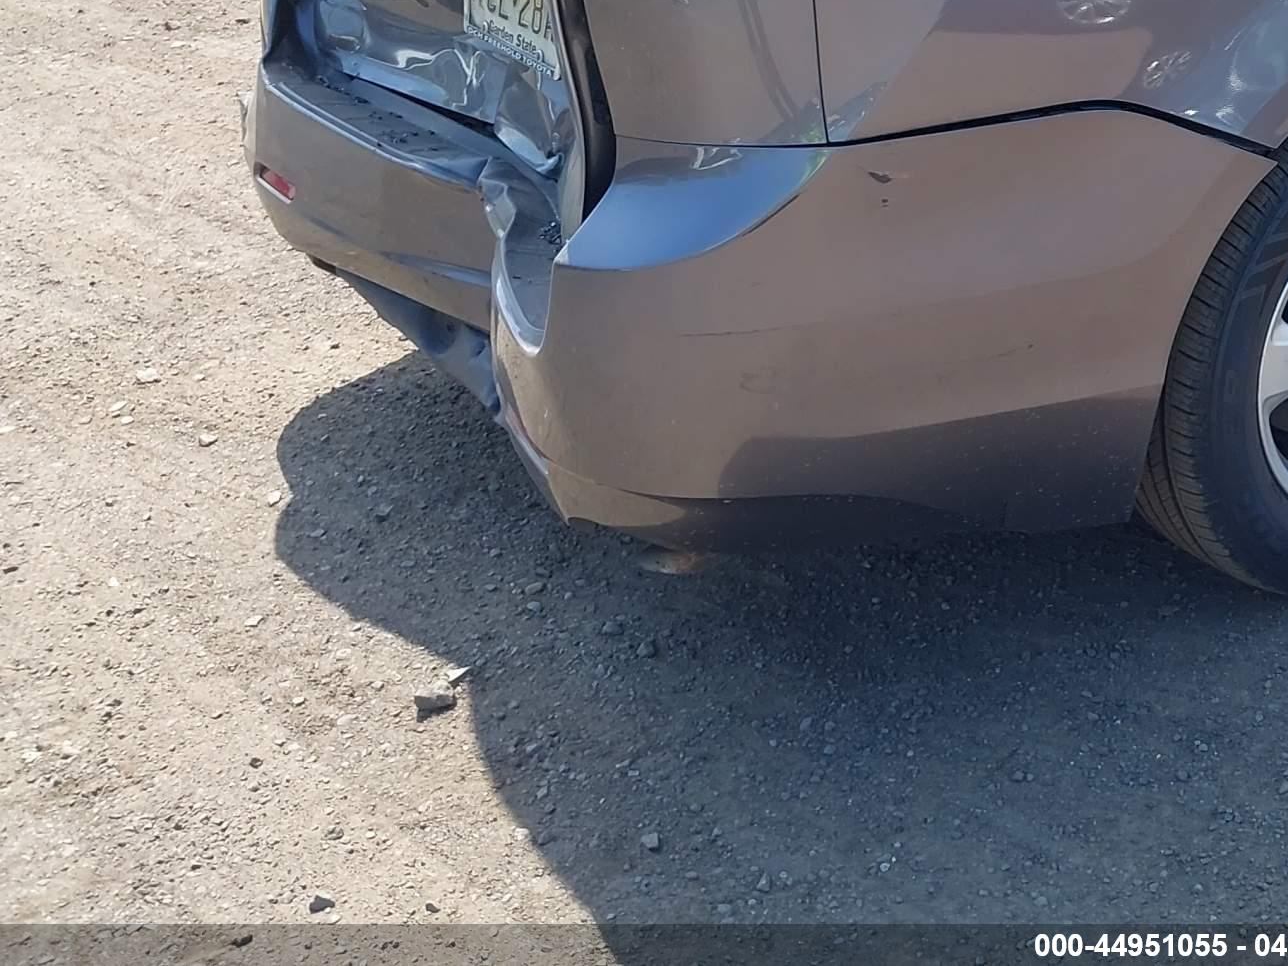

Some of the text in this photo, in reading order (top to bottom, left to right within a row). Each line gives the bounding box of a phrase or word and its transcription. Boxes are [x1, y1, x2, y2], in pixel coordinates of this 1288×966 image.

[489, 20, 537, 53] Garden State
[522, 56, 552, 77] TOYOTA
